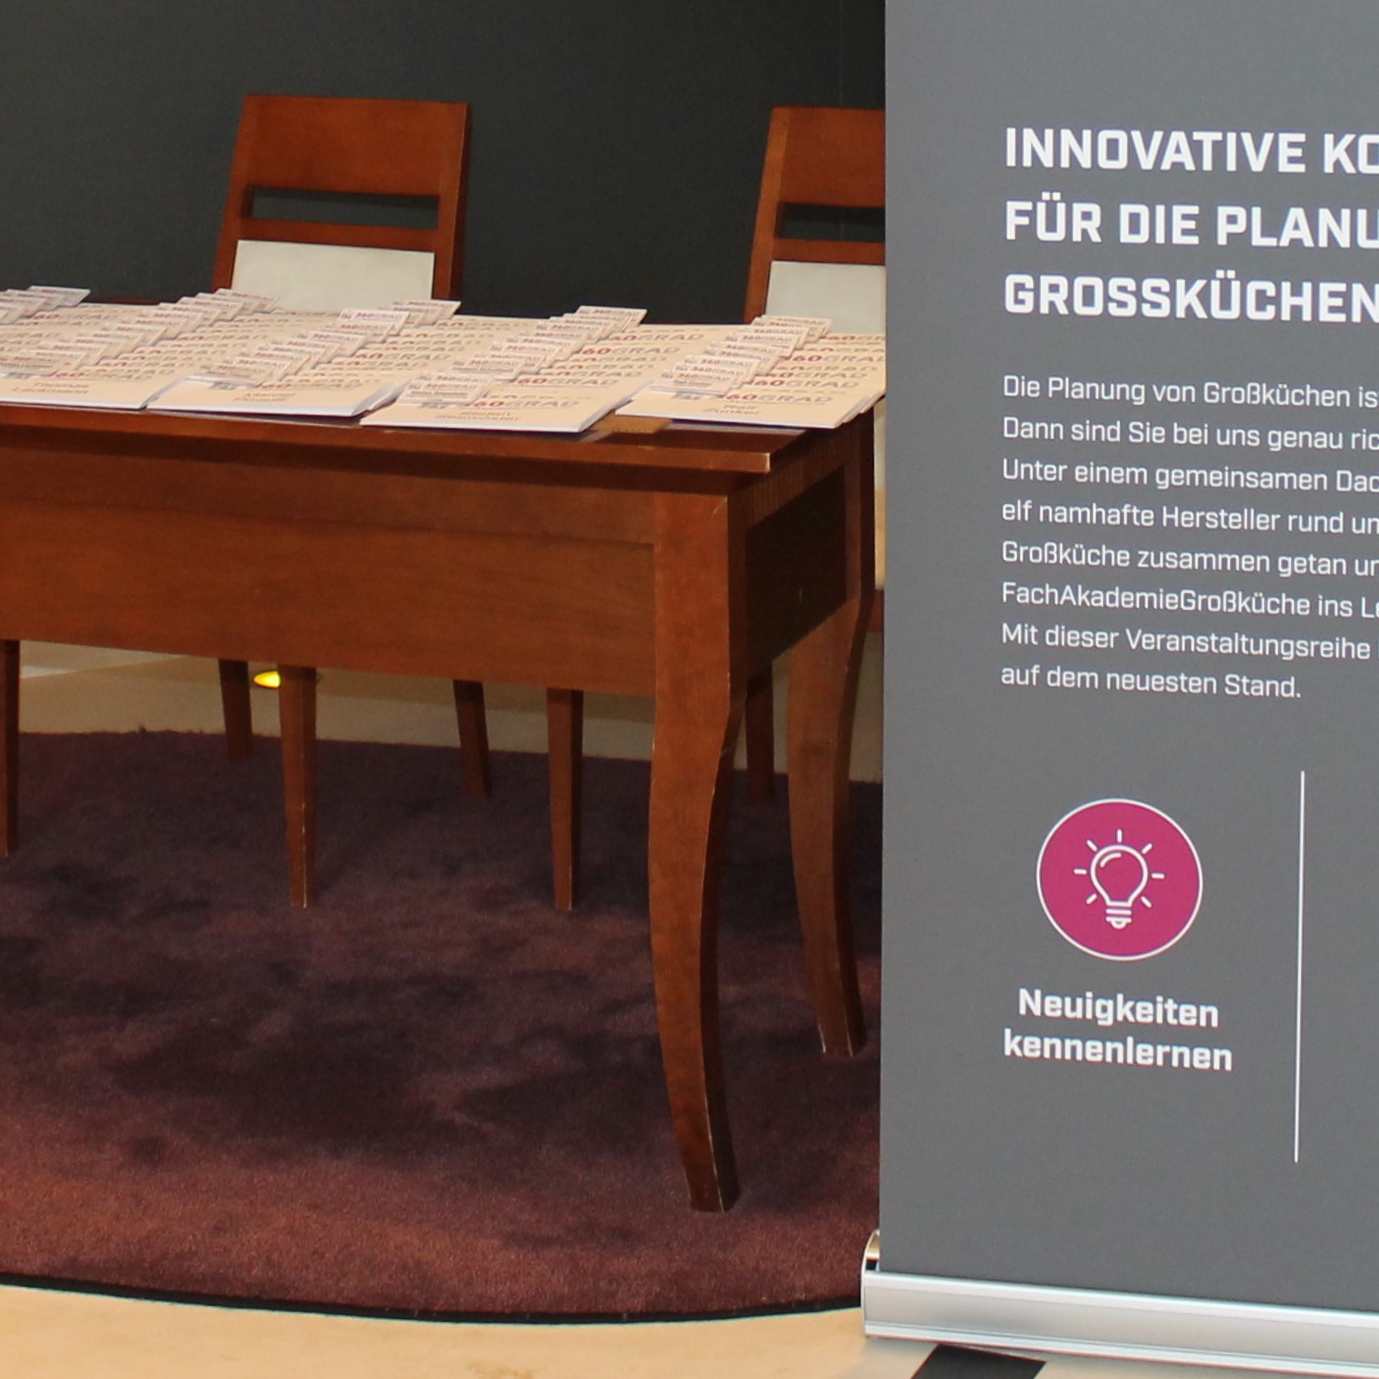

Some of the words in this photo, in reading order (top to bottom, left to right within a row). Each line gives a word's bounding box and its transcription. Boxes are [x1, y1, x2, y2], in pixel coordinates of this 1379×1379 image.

[1006, 127, 1306, 173] INNOVATIVE
[1006, 191, 1102, 243] FÜR
[1119, 203, 1200, 245] DIE
[1003, 374, 1041, 398] Die
[1048, 376, 1146, 406] Planung
[1152, 384, 1196, 403] von
[1203, 381, 1351, 407] Großküchen
[1003, 416, 1064, 440] Dann
[1071, 419, 1121, 442] sind
[1128, 421, 1166, 444] Sie
[1173, 422, 1209, 445] bei
[1216, 428, 1261, 447] uns
[1267, 430, 1343, 452] genau
[1003, 458, 1068, 482] Unter
[1074, 461, 1148, 485] einem
[1155, 465, 1328, 491] gemeinsamen
[1002, 499, 1033, 522] elf
[1039, 502, 1155, 527] namhafte
[1162, 505, 1281, 531] Hersteller
[1288, 511, 1344, 533] rund
[1002, 540, 1130, 567] Großküche
[1137, 550, 1270, 573] zusammen
[1277, 553, 1347, 578] getan
[1002, 581, 1311, 616] FachAkademieGroßküche
[1318, 594, 1353, 618] ins
[1002, 622, 1039, 646] Mit
[1045, 624, 1120, 649] dieser
[1125, 628, 1371, 661] Veranstaltungsreihe
[1001, 664, 1041, 686] auf
[1046, 665, 1099, 689] dem
[1106, 672, 1217, 695] neuesten
[1224, 673, 1301, 698] Stand.
[1019, 988, 1219, 1028] Neuigkeiten
[1004, 1027, 1232, 1072] kennenlernen
